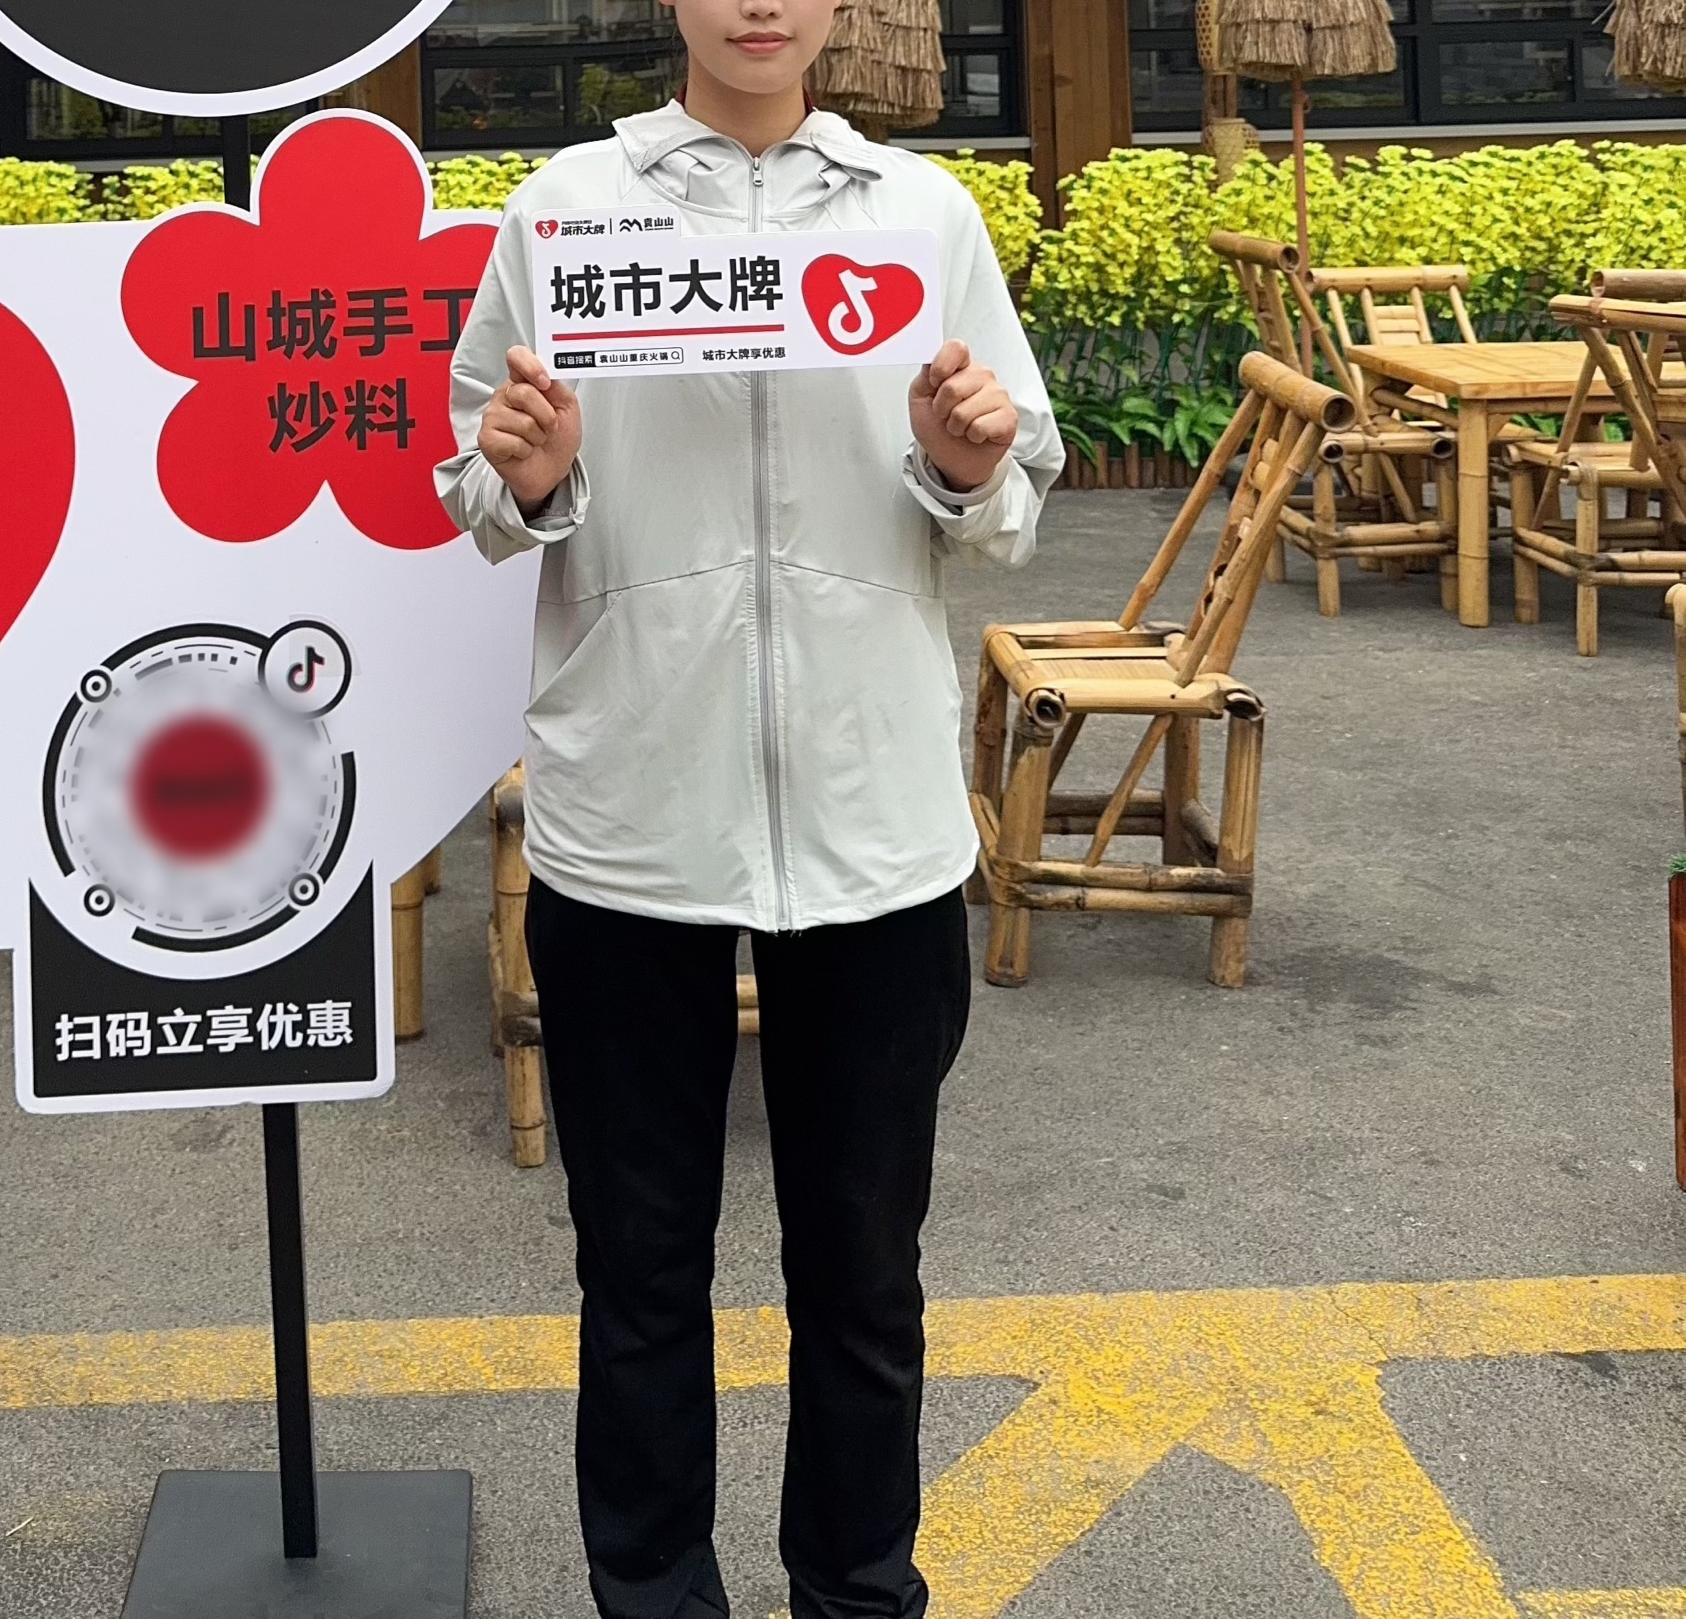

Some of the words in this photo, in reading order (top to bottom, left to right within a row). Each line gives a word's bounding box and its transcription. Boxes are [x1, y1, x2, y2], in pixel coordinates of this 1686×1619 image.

[560, 224, 606, 237] 城市大牌
[644, 216, 674, 228] 袁山山
[550, 255, 784, 320] 城市大牌
[191, 286, 479, 363] 山城手工
[599, 351, 669, 364] 袁山山重庆火锅
[702, 346, 787, 362] 城市大牌享优惠
[267, 376, 417, 454] 炒料
[54, 998, 355, 1062] 扫码立享优惠
